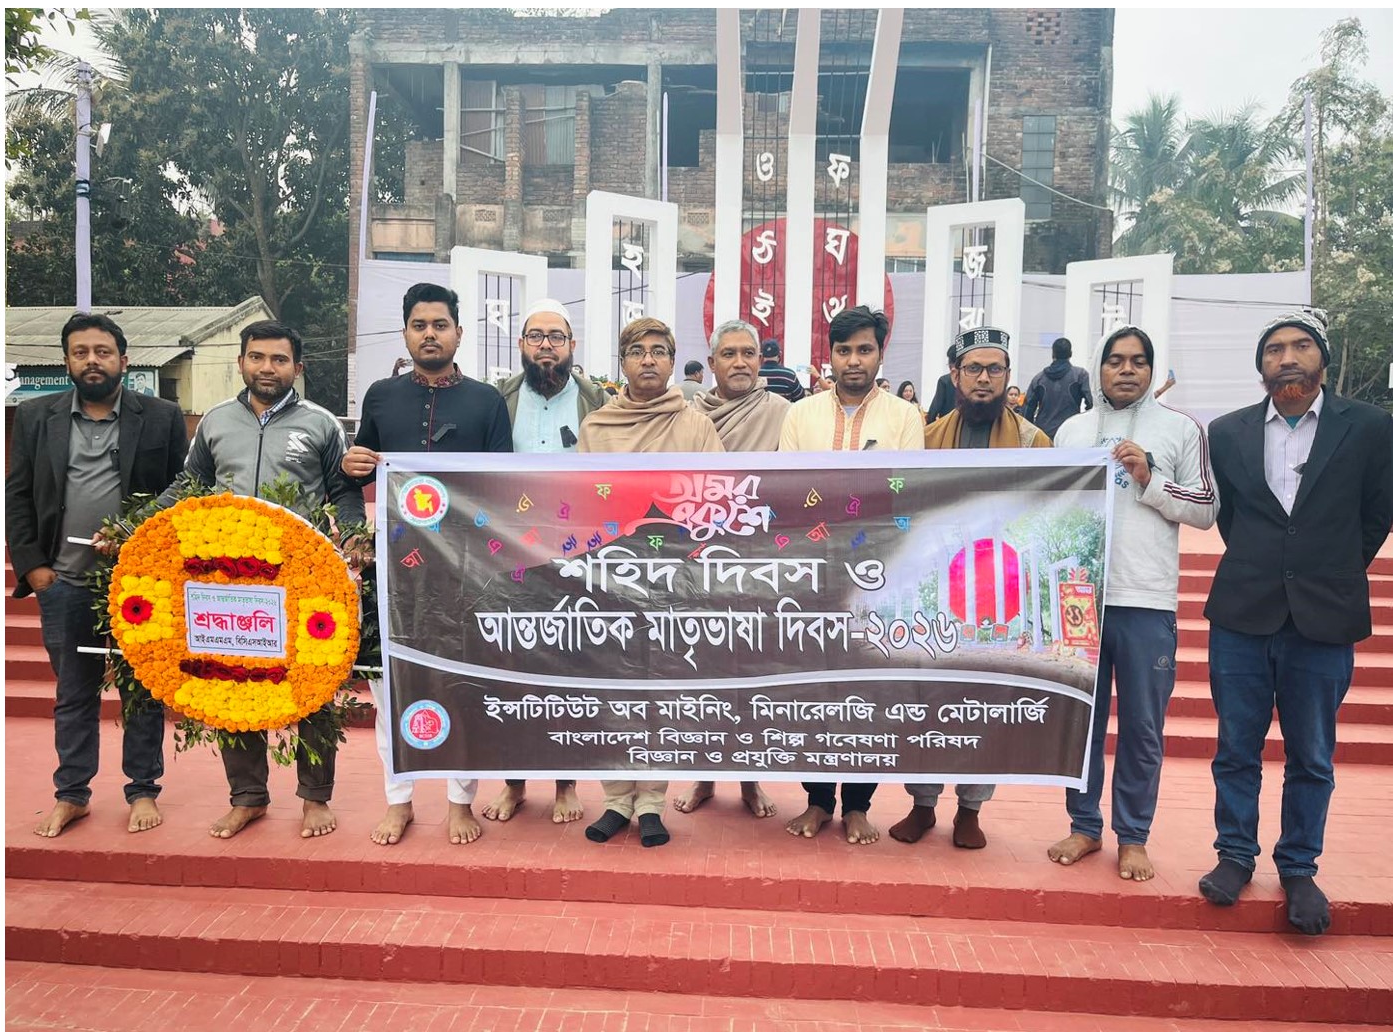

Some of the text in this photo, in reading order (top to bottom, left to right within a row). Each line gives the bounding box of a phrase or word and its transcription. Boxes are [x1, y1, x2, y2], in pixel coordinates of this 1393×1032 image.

[827, 153, 851, 188] ফ
[20, 375, 69, 390] anagement
[552, 545, 886, 598] শহিদ দিবস ও
[193, 609, 276, 634] শ্রদ্ধাঞ্জলি
[474, 595, 958, 672] আন্তর্জাতিক মাতৃভাষা দিবস-২০২৬
[607, 699, 650, 721] অব
[655, 693, 741, 725] মাইনিং,
[749, 694, 877, 722] মিনারেলজি
[885, 702, 929, 723] এন্ড
[937, 696, 1050, 725] মেটালার্জি
[548, 726, 982, 750] বাংলাদেশ বিজ্ঞান ও শিল্প গবেষণা পরিষদ
[626, 746, 900, 769] বিজ্ঞান ও প্রযুক্তি মন্ত্রণালয়
